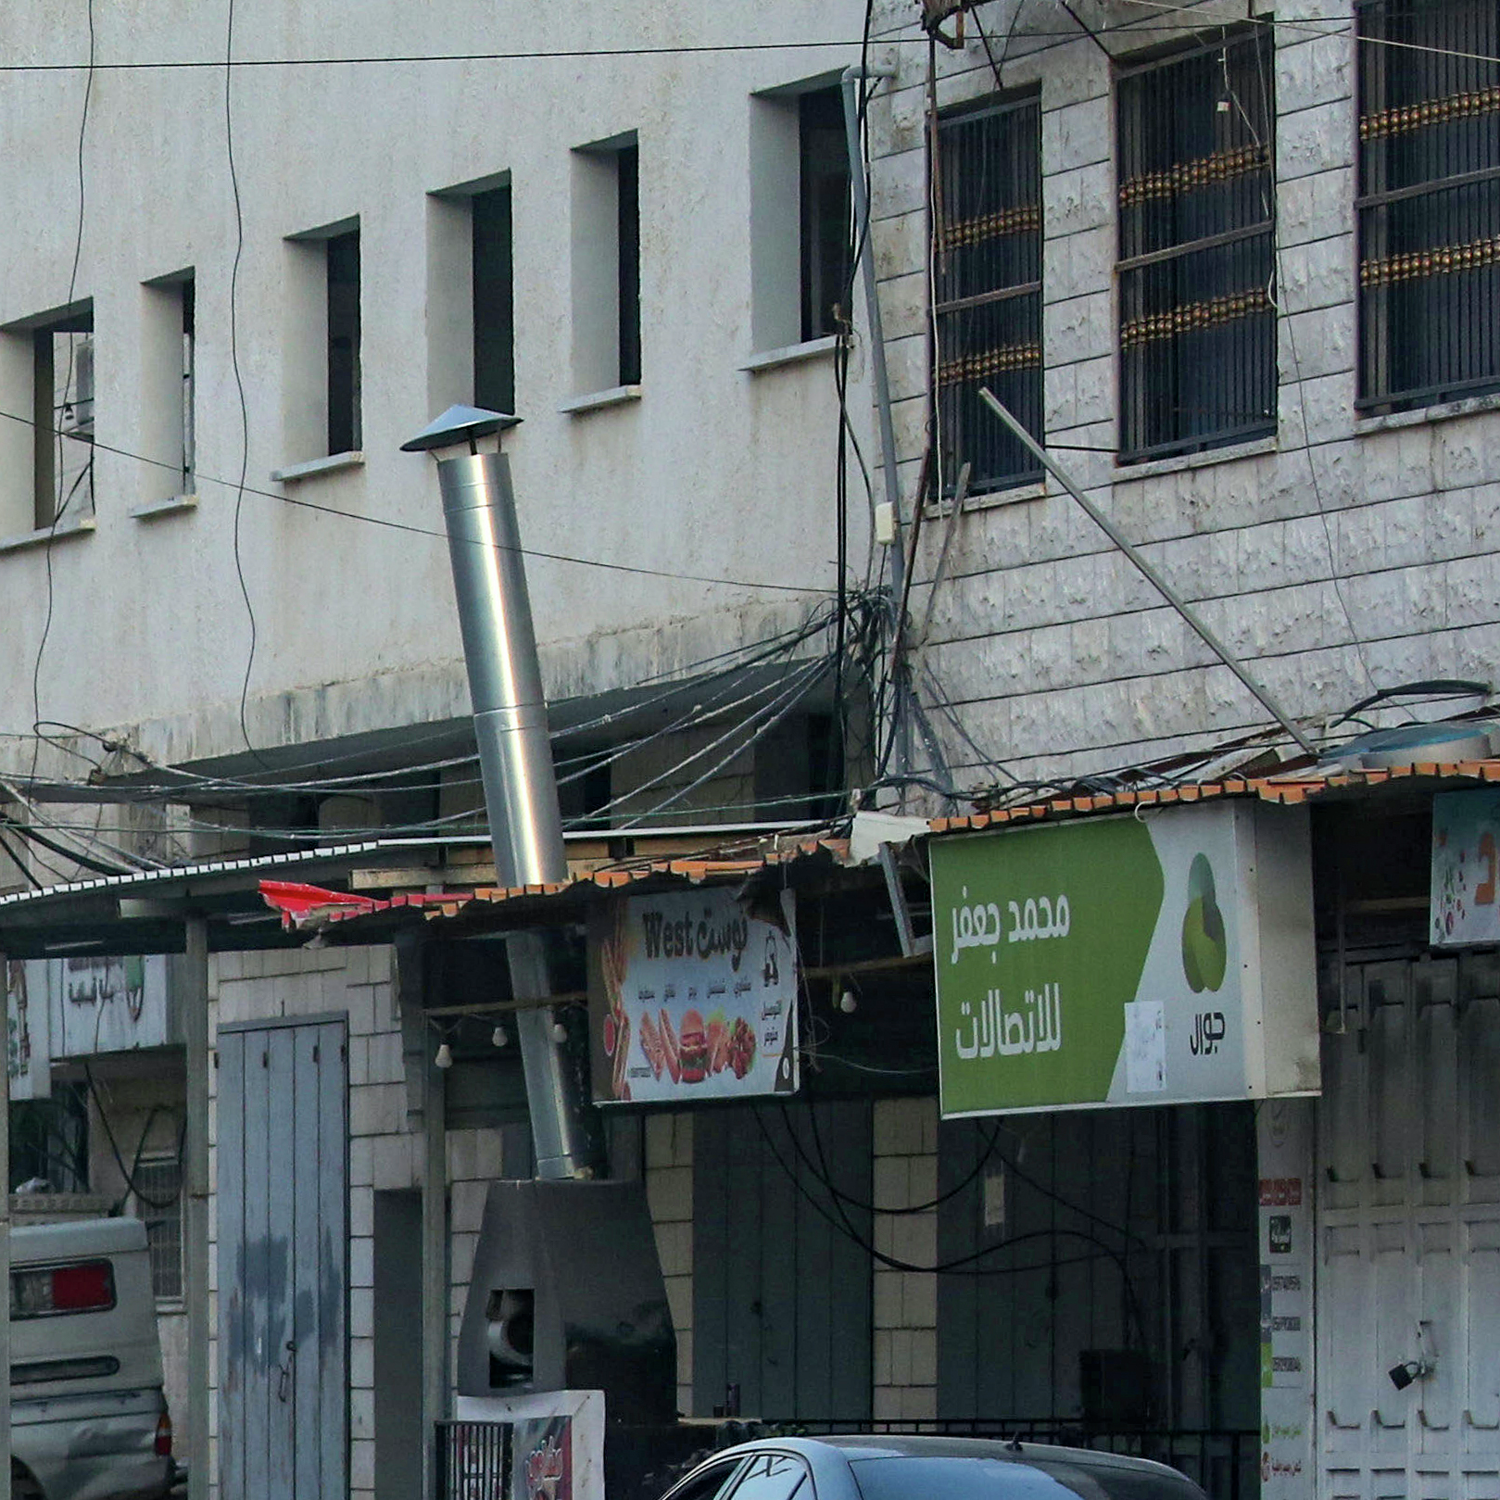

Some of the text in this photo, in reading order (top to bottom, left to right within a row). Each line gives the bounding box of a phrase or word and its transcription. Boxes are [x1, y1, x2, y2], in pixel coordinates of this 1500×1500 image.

[643, 912, 693, 957] West
[951, 885, 1071, 964] محمد جعفر
[956, 982, 1062, 1059] للاتصالات
[1190, 1011, 1225, 1055] جوال
